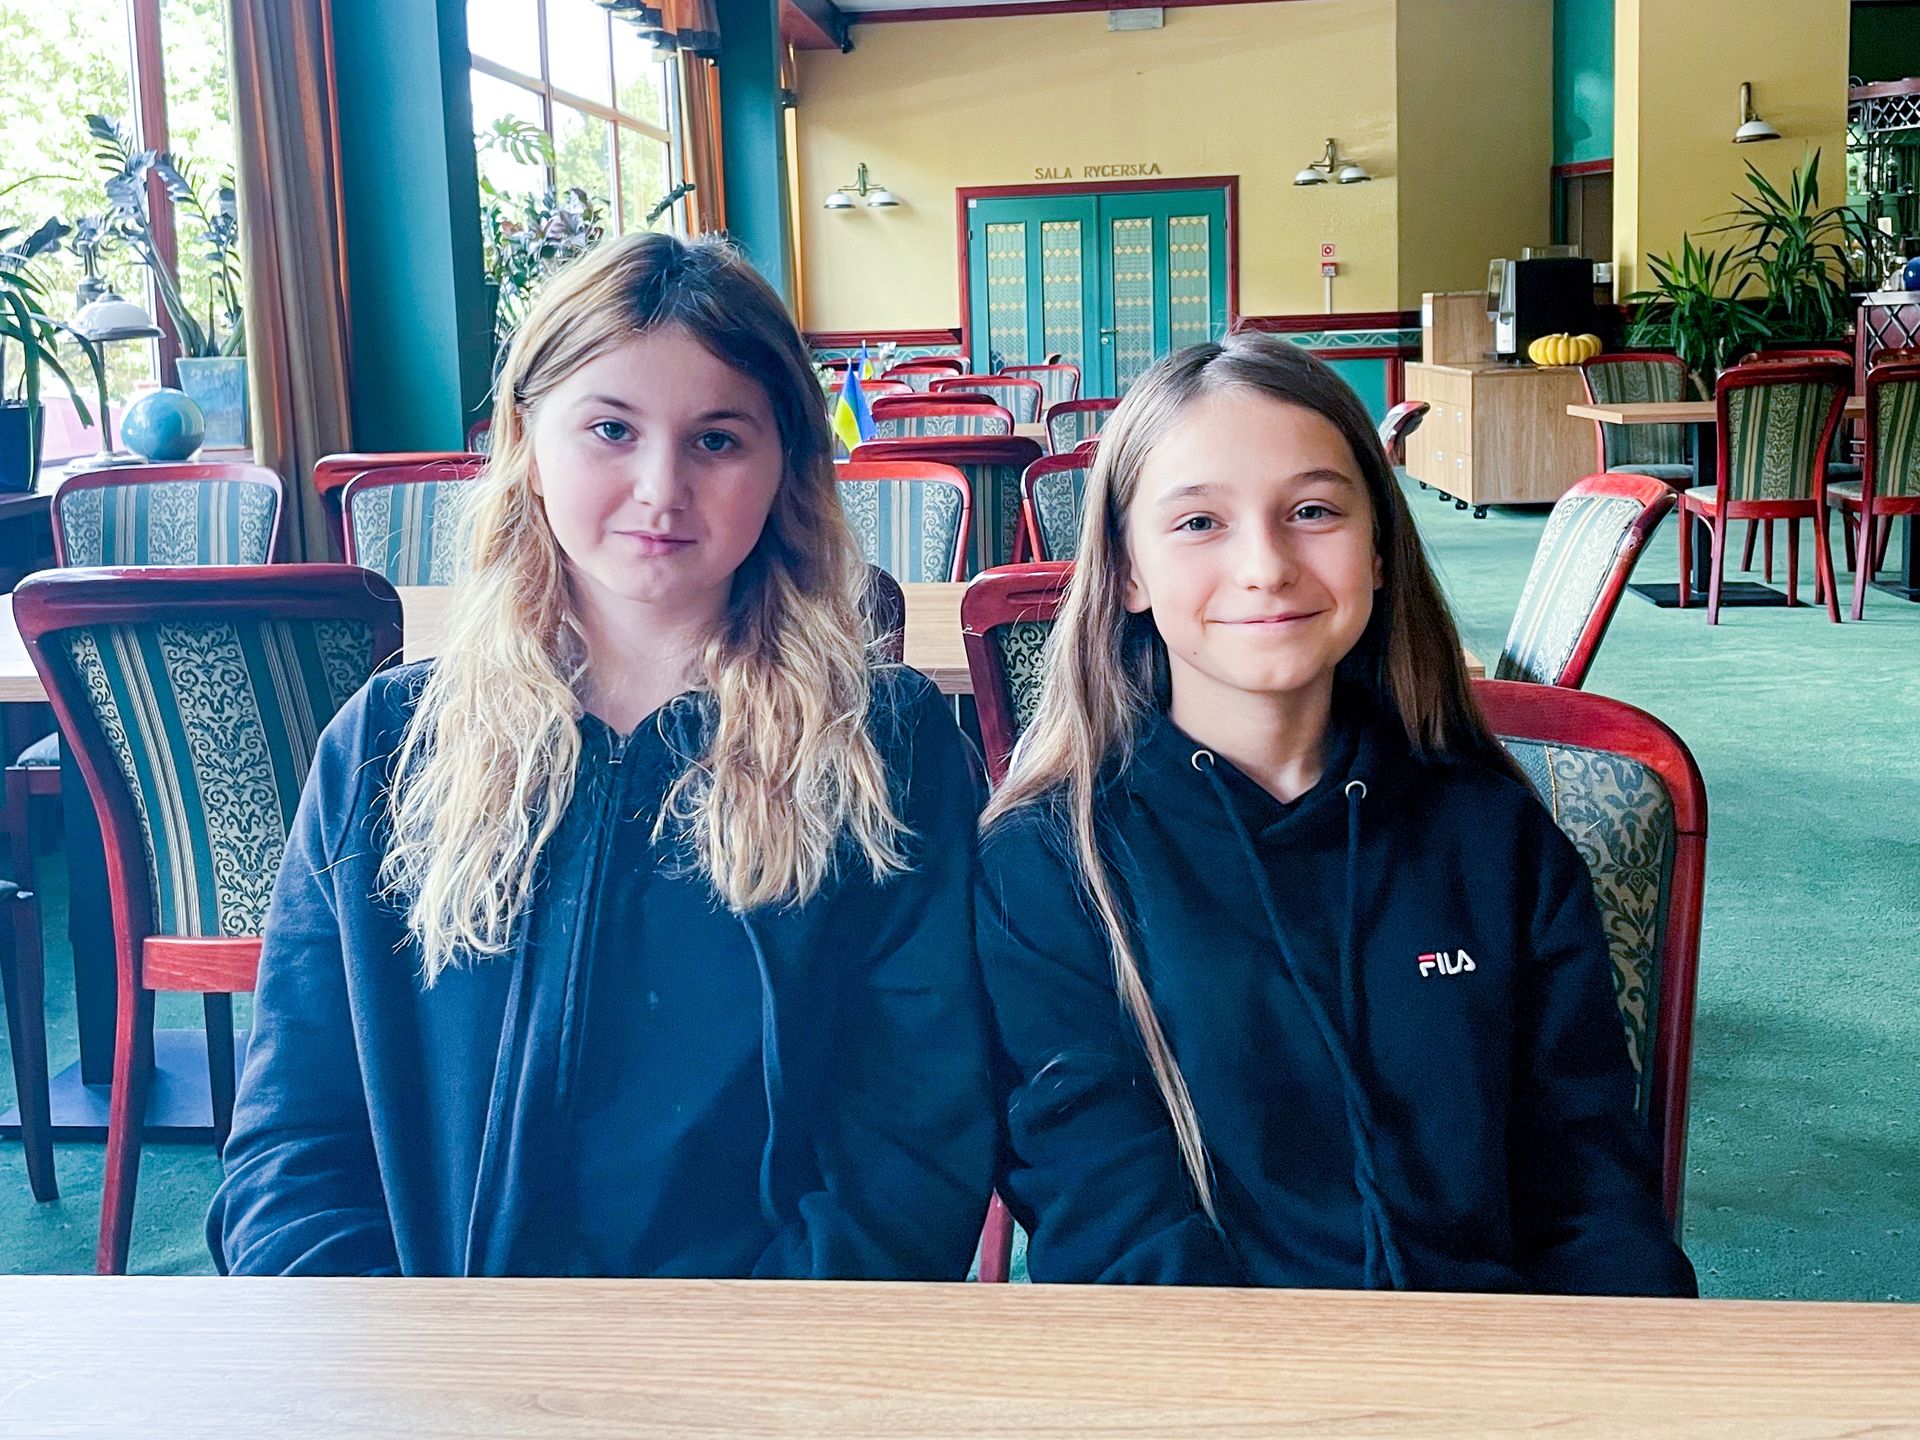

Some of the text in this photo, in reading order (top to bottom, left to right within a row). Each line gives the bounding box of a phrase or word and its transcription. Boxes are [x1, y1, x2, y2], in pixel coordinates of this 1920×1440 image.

[1035, 163, 1162, 180] SALA RYCERSKA
[1418, 949, 1476, 977] FILA
